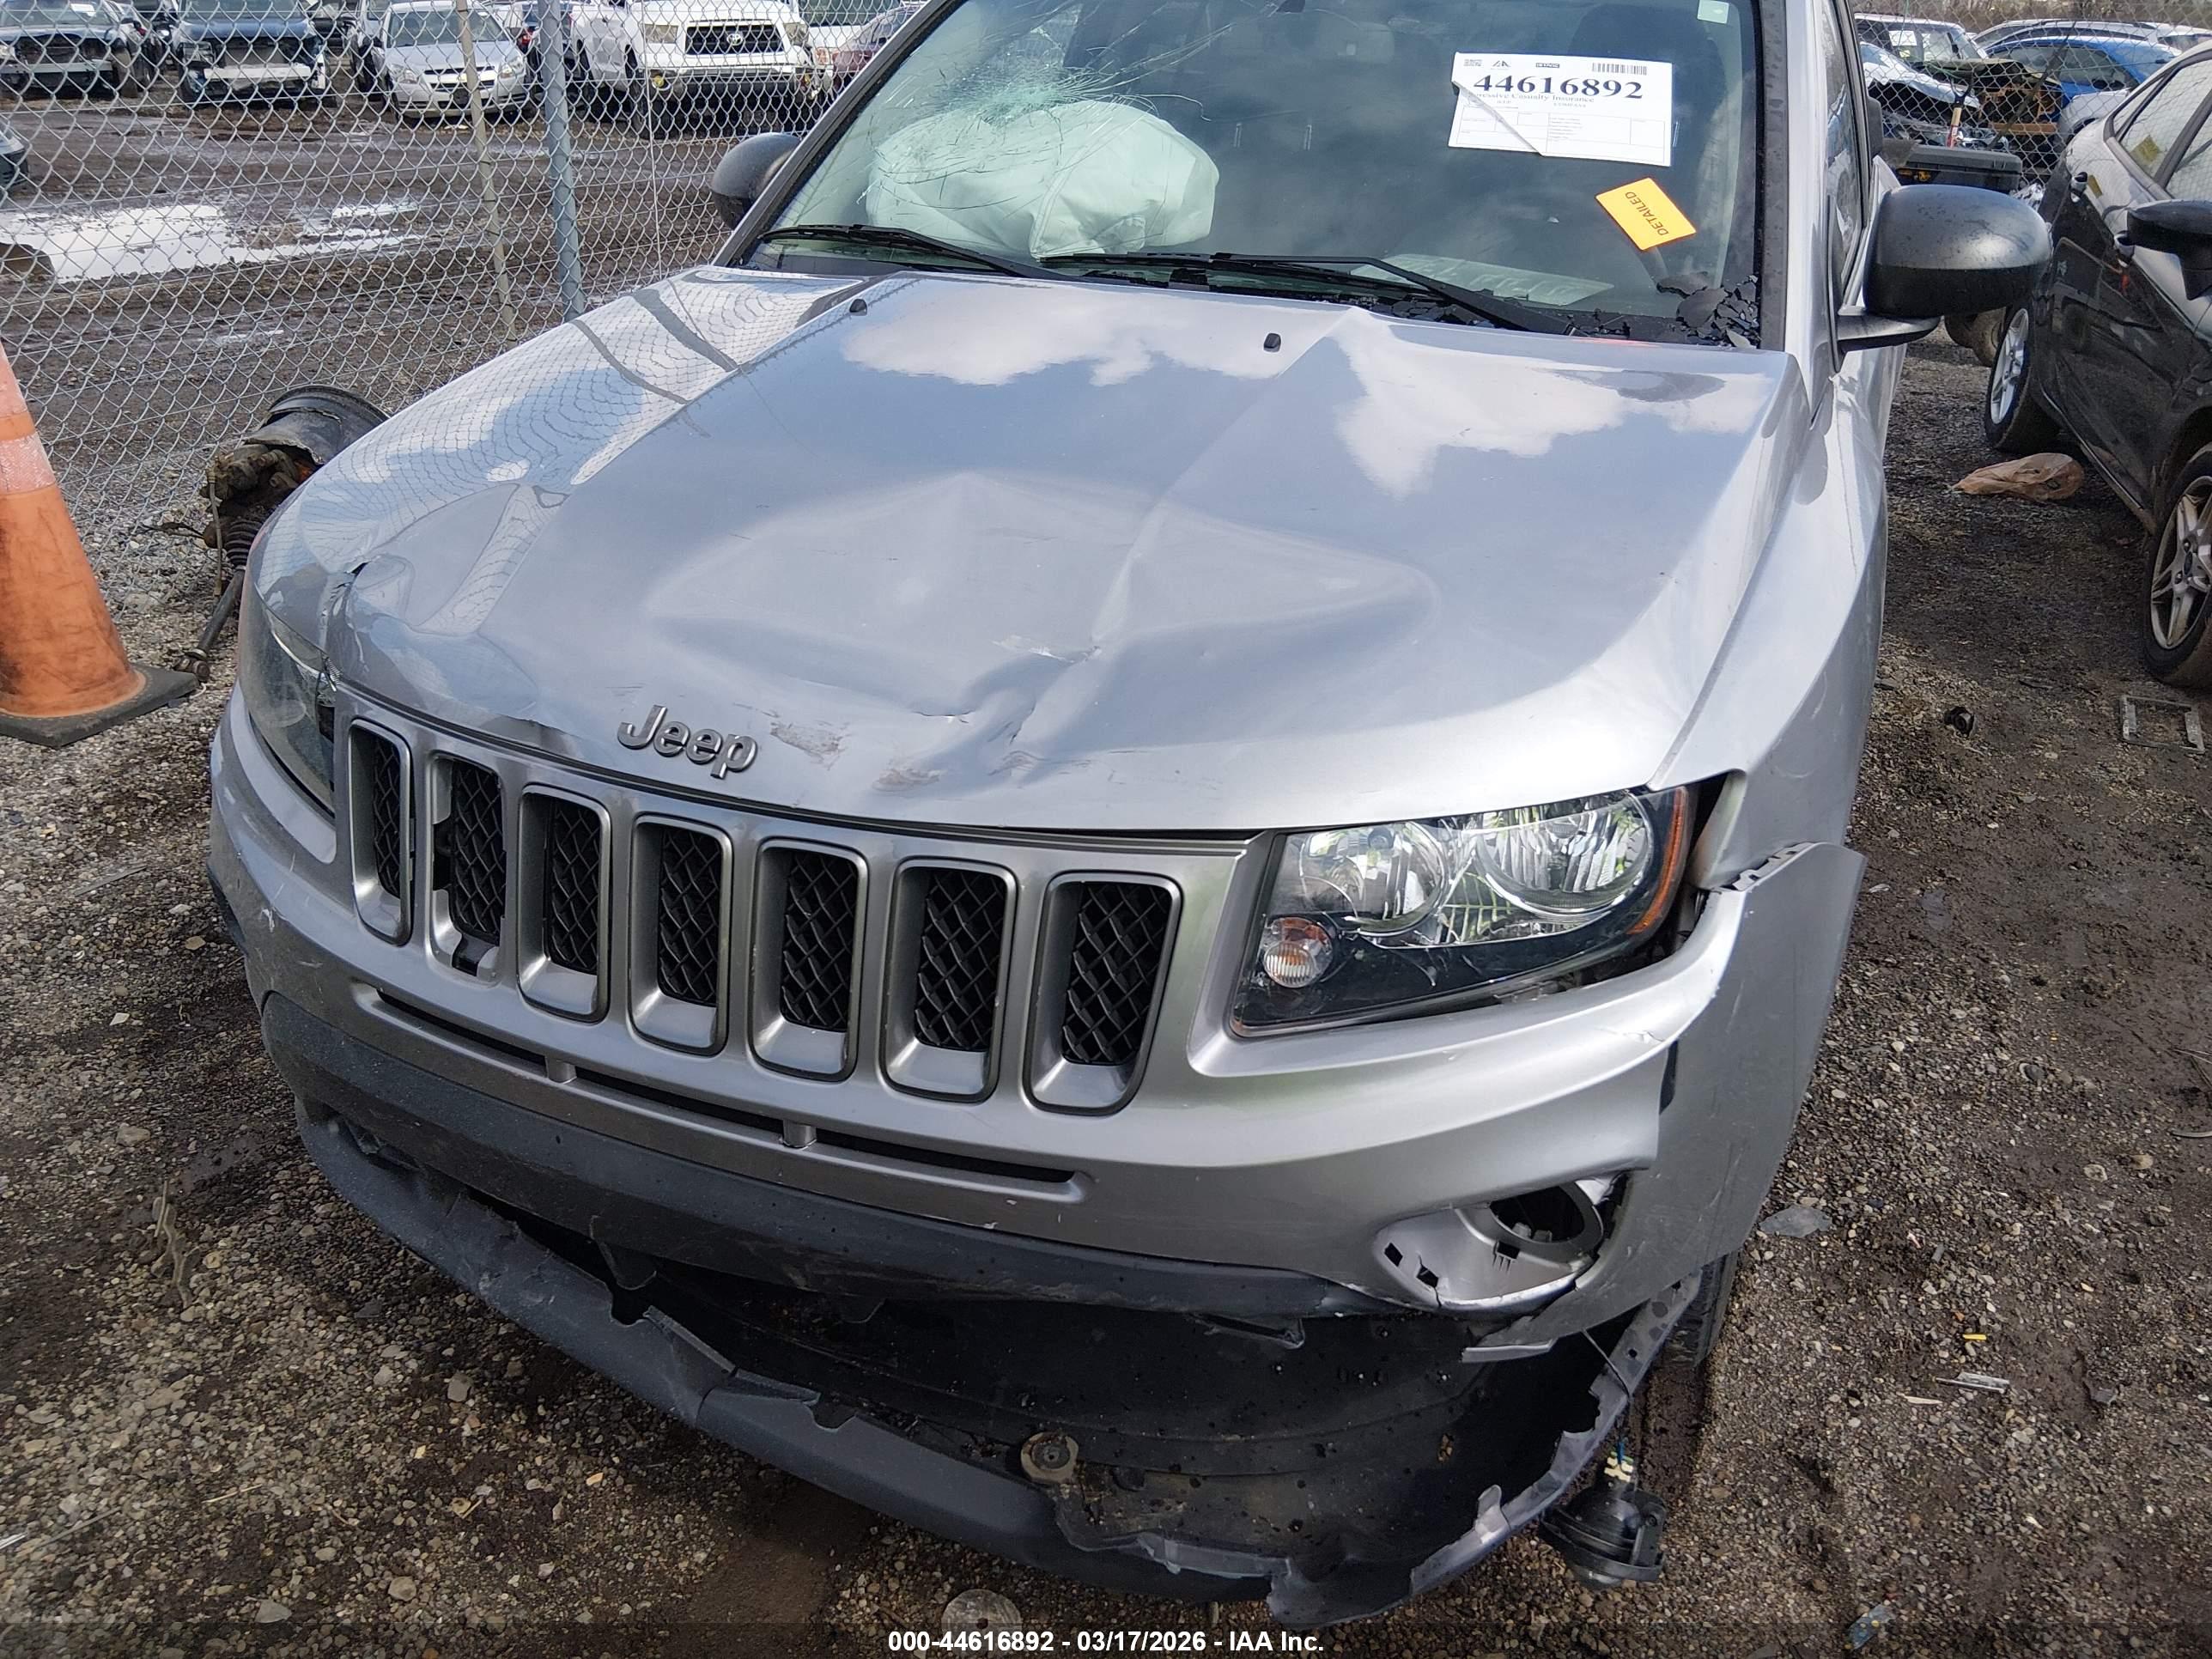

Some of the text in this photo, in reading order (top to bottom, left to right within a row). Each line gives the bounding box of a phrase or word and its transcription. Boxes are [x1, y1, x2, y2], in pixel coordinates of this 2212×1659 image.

[1473, 74, 1644, 99] 44616892
[1625, 191, 1669, 235] DETAILED
[617, 704, 758, 780] Jeep
